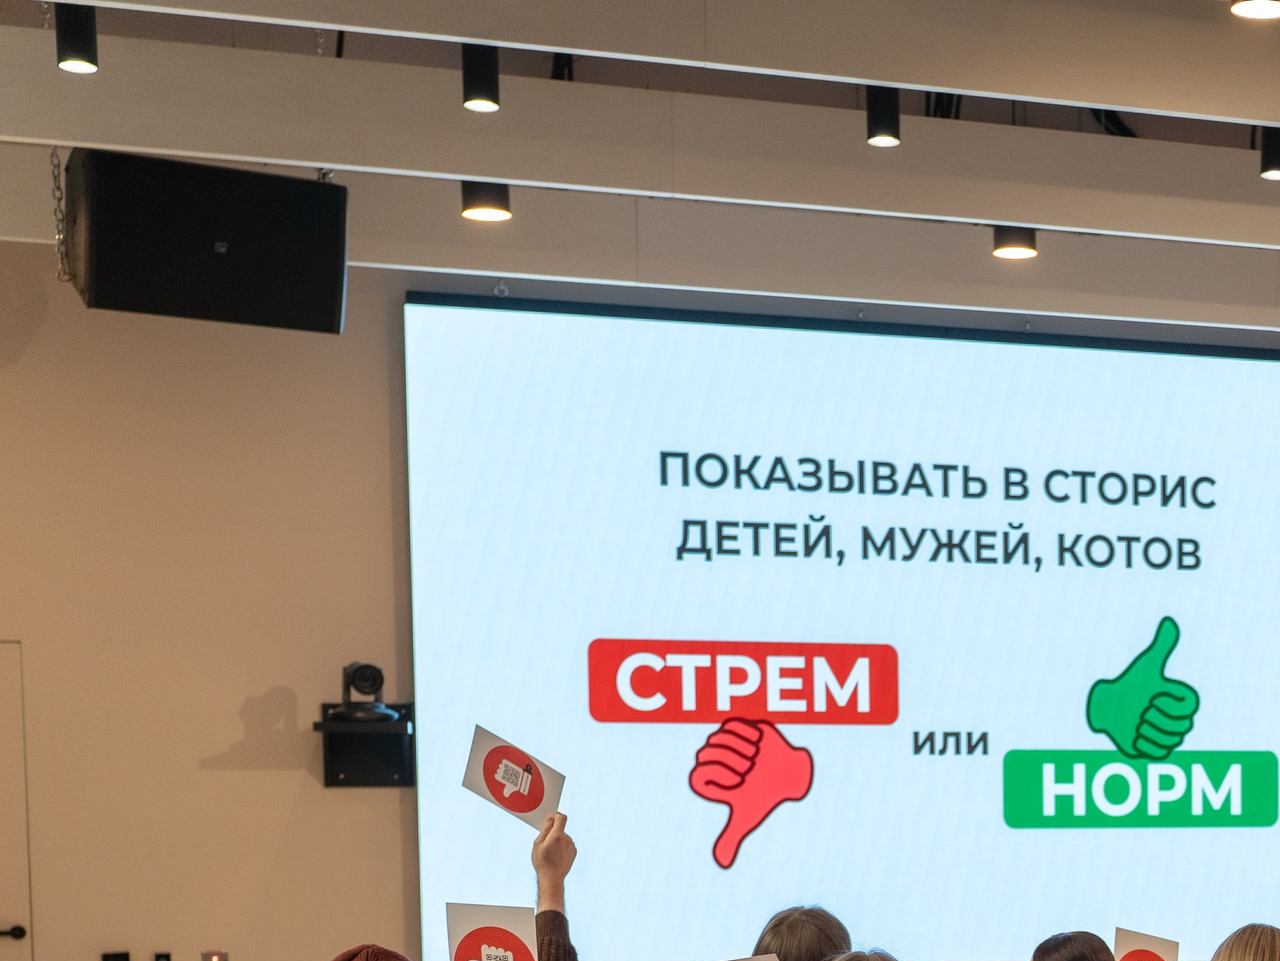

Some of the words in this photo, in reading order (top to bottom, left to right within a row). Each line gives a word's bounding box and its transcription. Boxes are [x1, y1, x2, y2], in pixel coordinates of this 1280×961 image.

[659, 450, 988, 500] ПОКАЗЫВАТЬ
[1003, 466, 1030, 501] В
[1043, 469, 1218, 511] СТОРИС
[676, 514, 846, 567] ДЕТЕЙ,
[861, 522, 1043, 573] МУЖЕЙ,
[1057, 533, 1202, 572] КОТОВ
[615, 652, 871, 713] СТРЕМ
[912, 731, 990, 756] или
[1042, 762, 1242, 817] НОРМ
